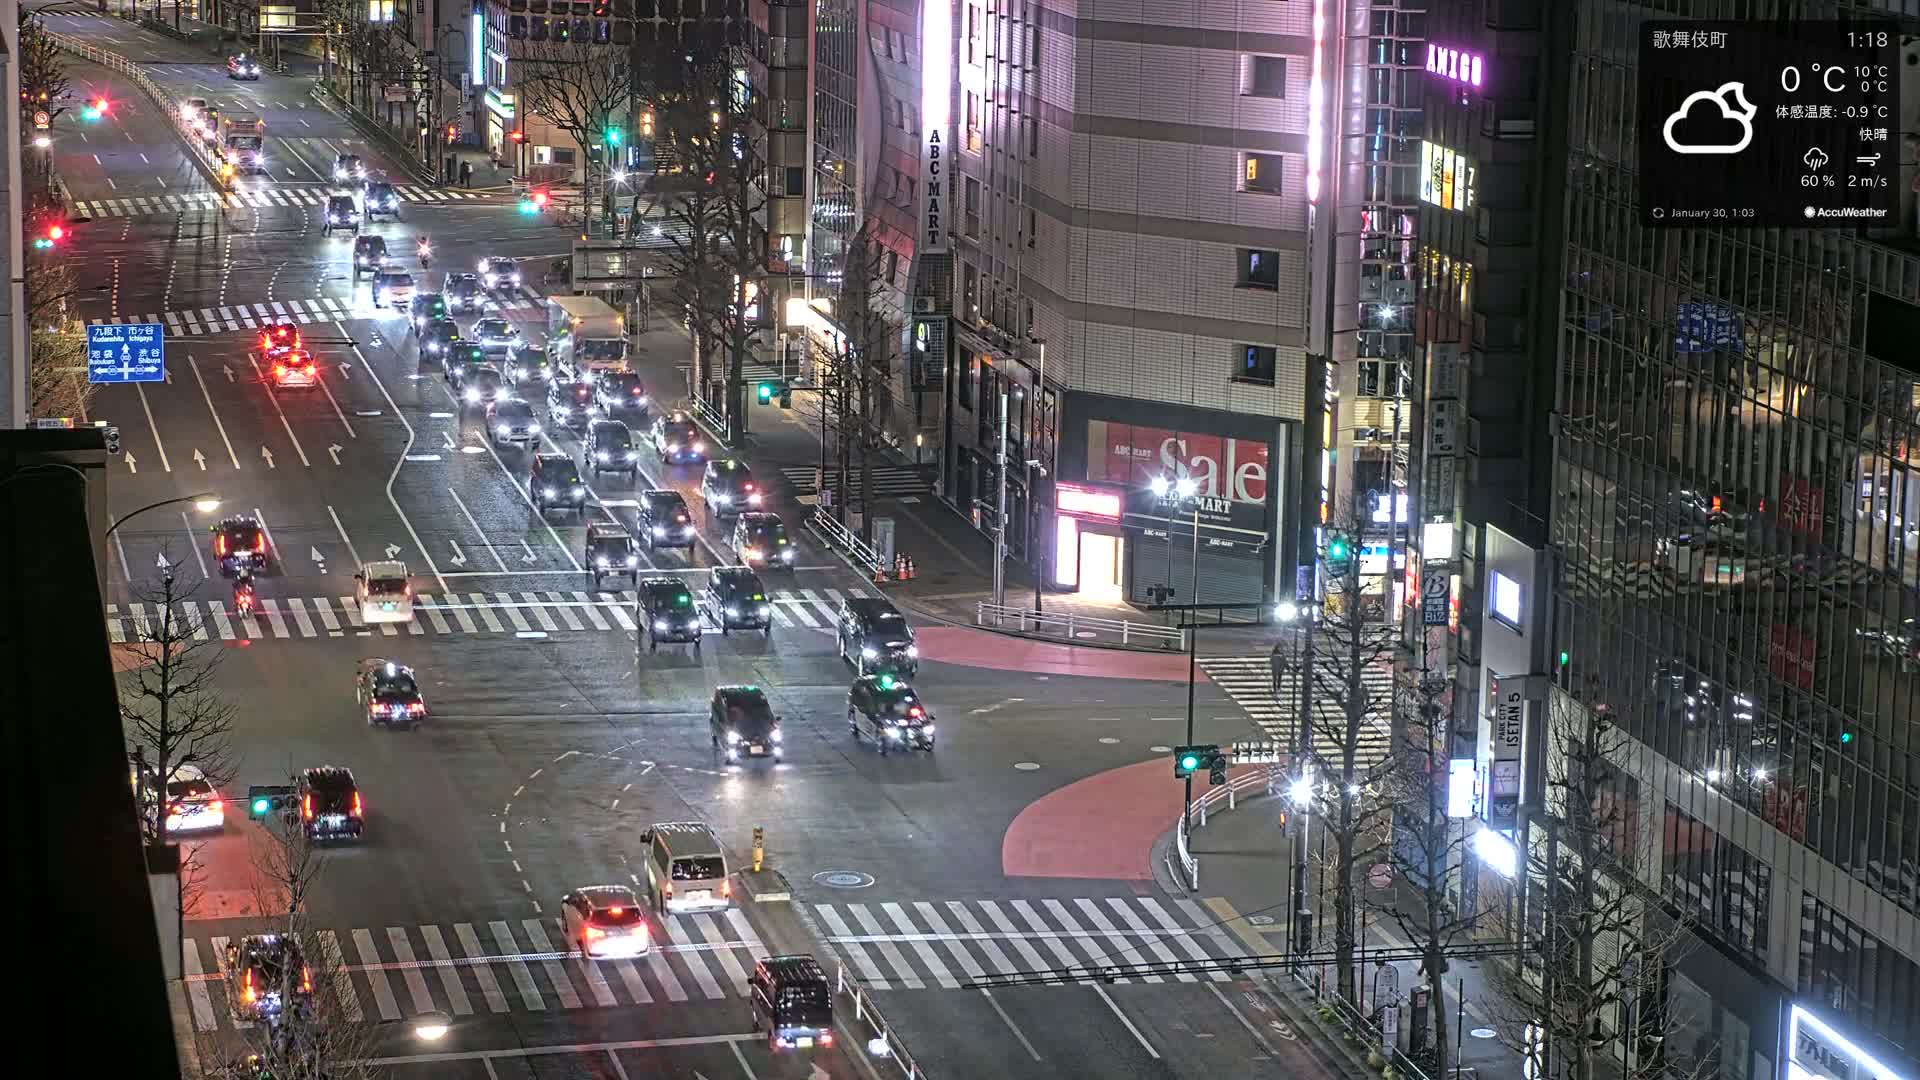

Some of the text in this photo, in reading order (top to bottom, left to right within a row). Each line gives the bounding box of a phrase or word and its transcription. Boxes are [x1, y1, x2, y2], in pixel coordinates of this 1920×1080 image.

[1426, 43, 1482, 86] AMIGO
[92, 335, 154, 343] Kudanshita Ichigaya
[95, 326, 123, 336] 九段下
[137, 357, 161, 365] Shibuya
[1159, 437, 1267, 506] Sale
[1499, 703, 1507, 721] CITY
[1506, 692, 1521, 747] ISETAN 5
